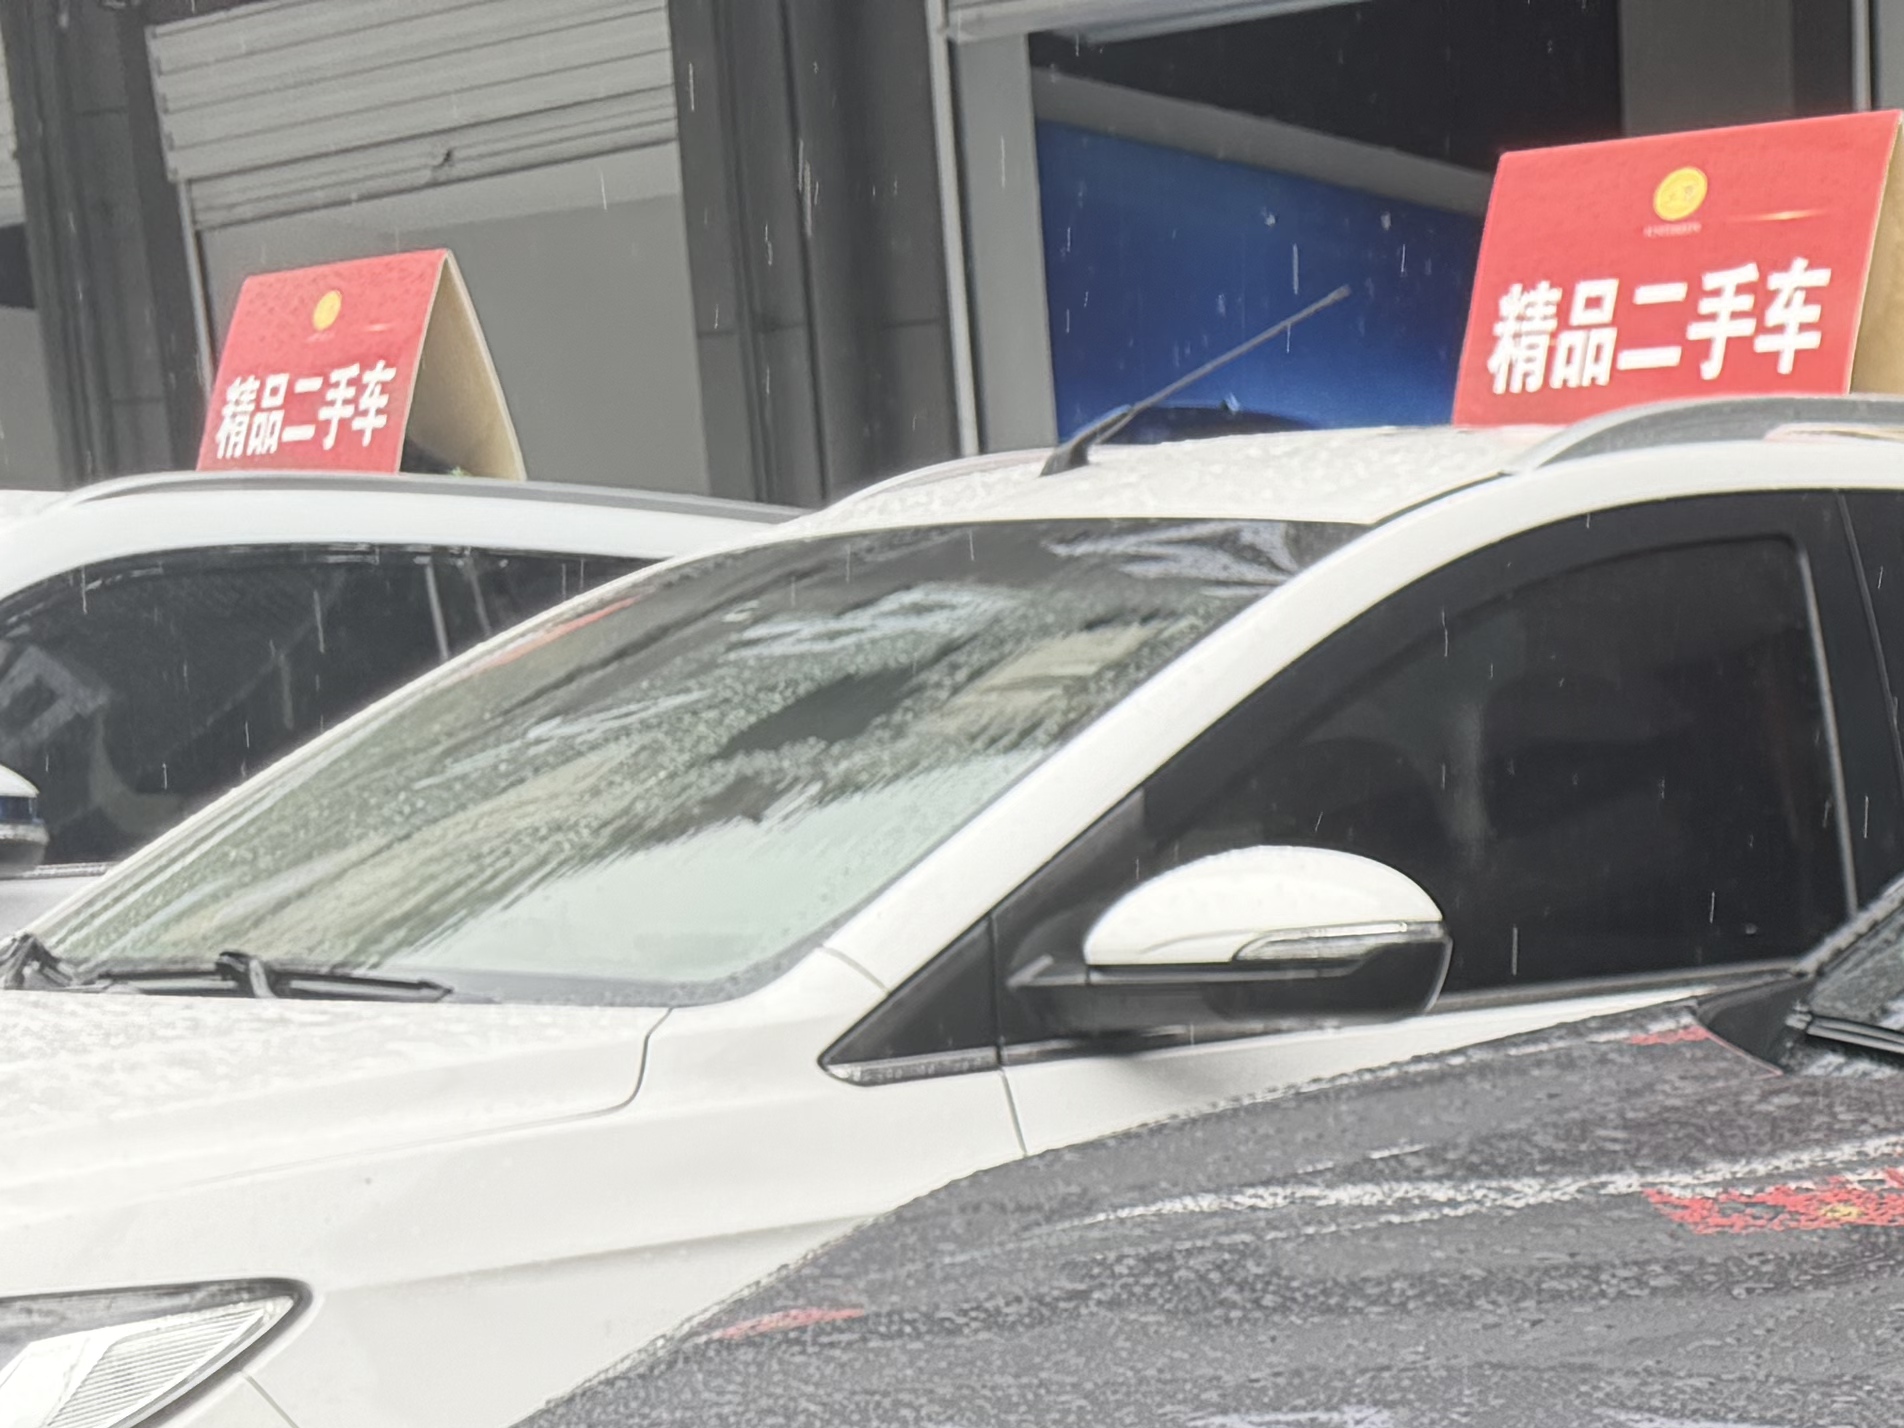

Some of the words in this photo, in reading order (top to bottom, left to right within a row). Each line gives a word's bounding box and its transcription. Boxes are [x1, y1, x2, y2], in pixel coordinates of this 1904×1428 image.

[1487, 257, 1832, 394] 精品二手车
[215, 359, 397, 459] 精品二手车
